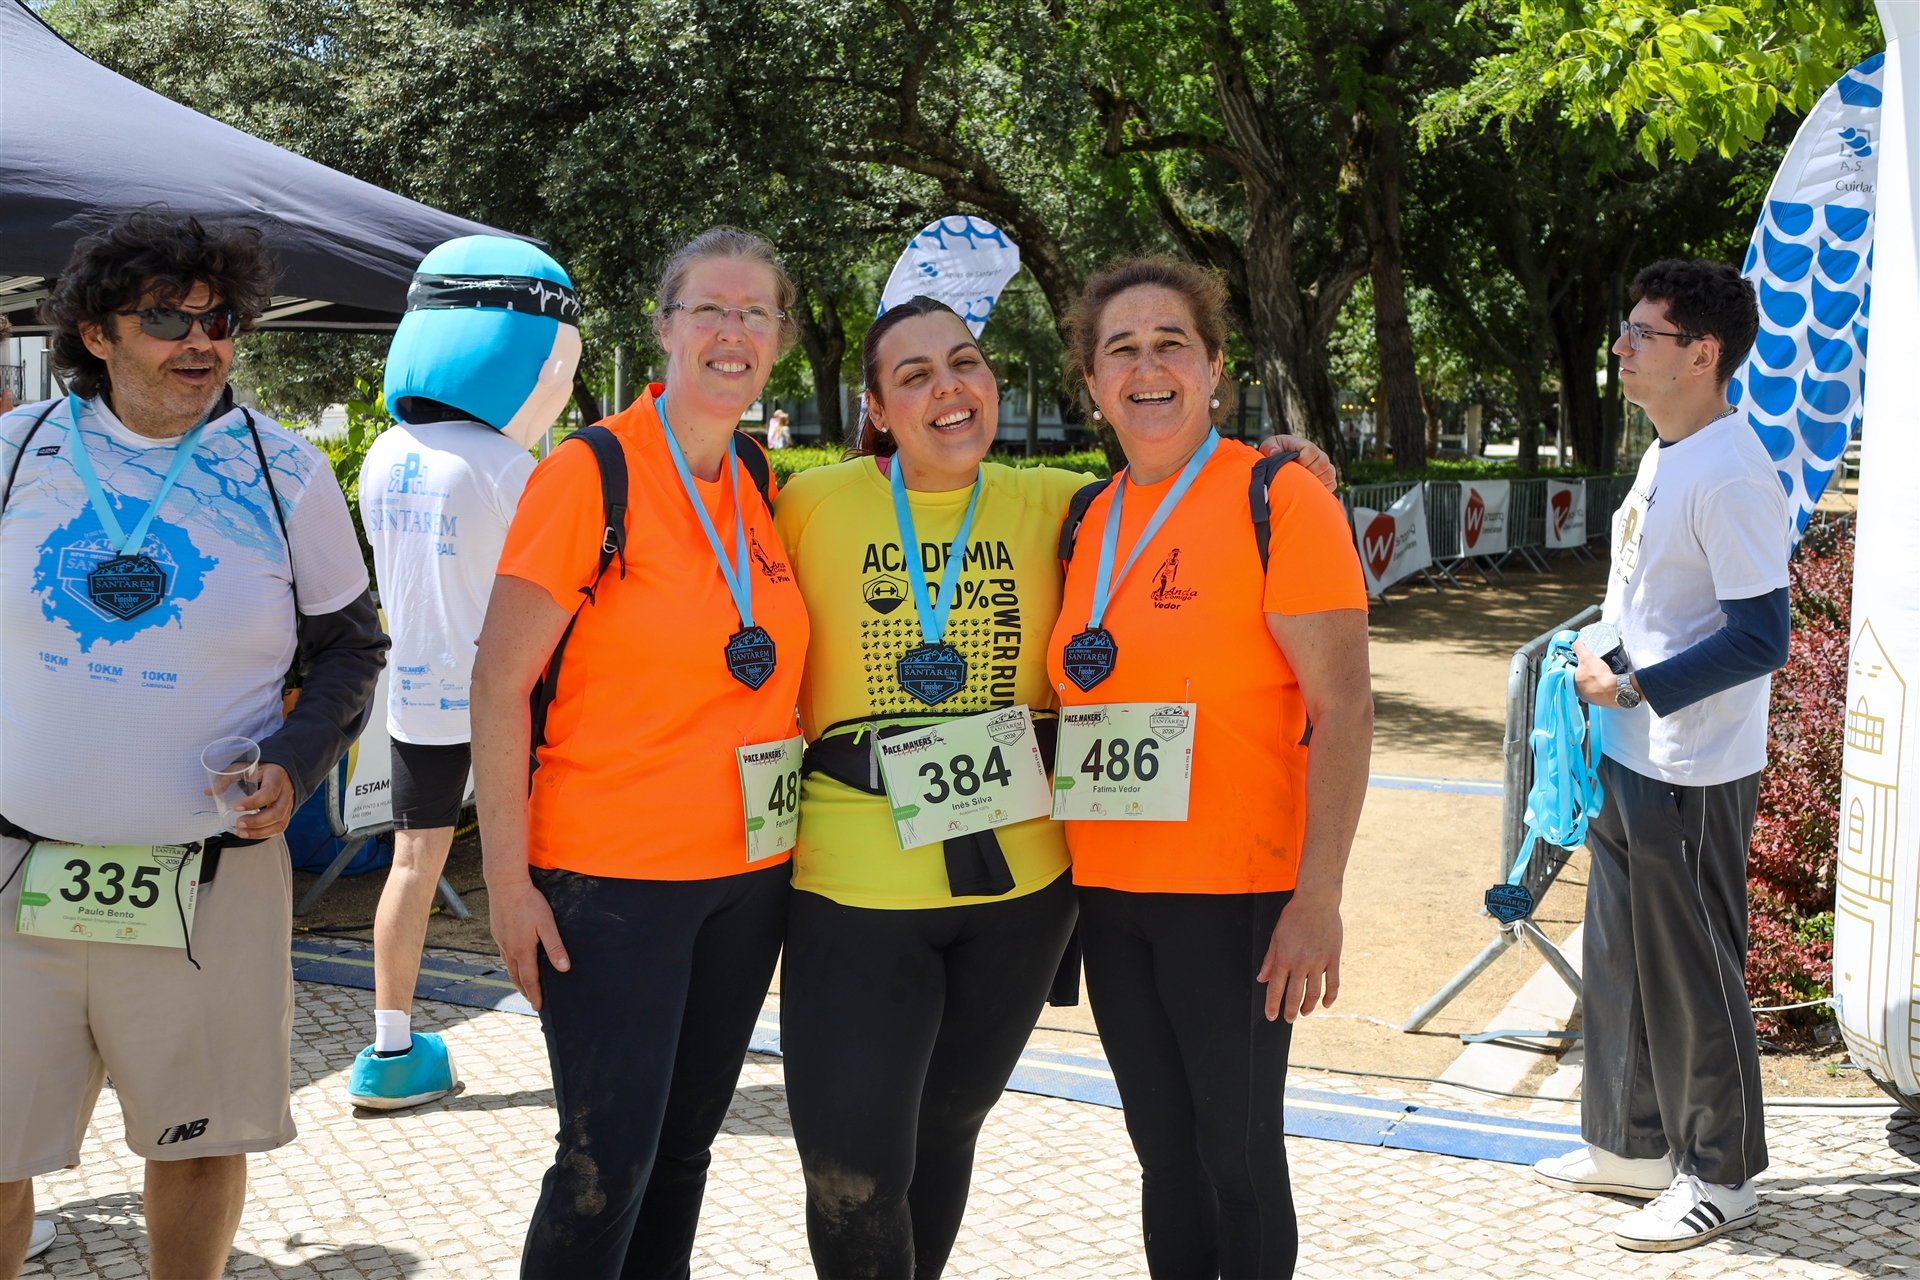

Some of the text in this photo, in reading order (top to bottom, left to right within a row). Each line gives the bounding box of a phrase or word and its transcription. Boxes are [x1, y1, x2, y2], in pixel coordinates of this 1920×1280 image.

[1840, 161, 1864, 172] A.S.
[1835, 180, 1875, 193] Cuidar.
[96, 579, 155, 589] SANTARÉM
[910, 580, 989, 610] 00%
[1164, 586, 1198, 597] Anda
[113, 594, 140, 603] Finisher
[1154, 601, 1182, 610] Vedor
[38, 651, 69, 667] 18KM
[732, 649, 770, 661] SANTARÉM
[1068, 651, 1108, 661] SANTARÉM
[87, 662, 123, 677] 10KM
[904, 667, 957, 676] SANTARÉM
[141, 670, 177, 683] 10KM
[920, 681, 944, 691] Finisher
[1152, 717, 1185, 725] SANTARÉM
[1080, 738, 1160, 782] 486
[918, 745, 1012, 804] 384
[355, 778, 392, 796] ESTAM
[768, 767, 802, 817] 48
[1093, 785, 1141, 793] Fatima Vedor
[363, 802, 376, 810] PINTO
[952, 795, 993, 811] Inês Silva
[155, 848, 187, 856] SANTAR
[60, 858, 161, 908] 335
[78, 907, 135, 919] Paulo Bento
